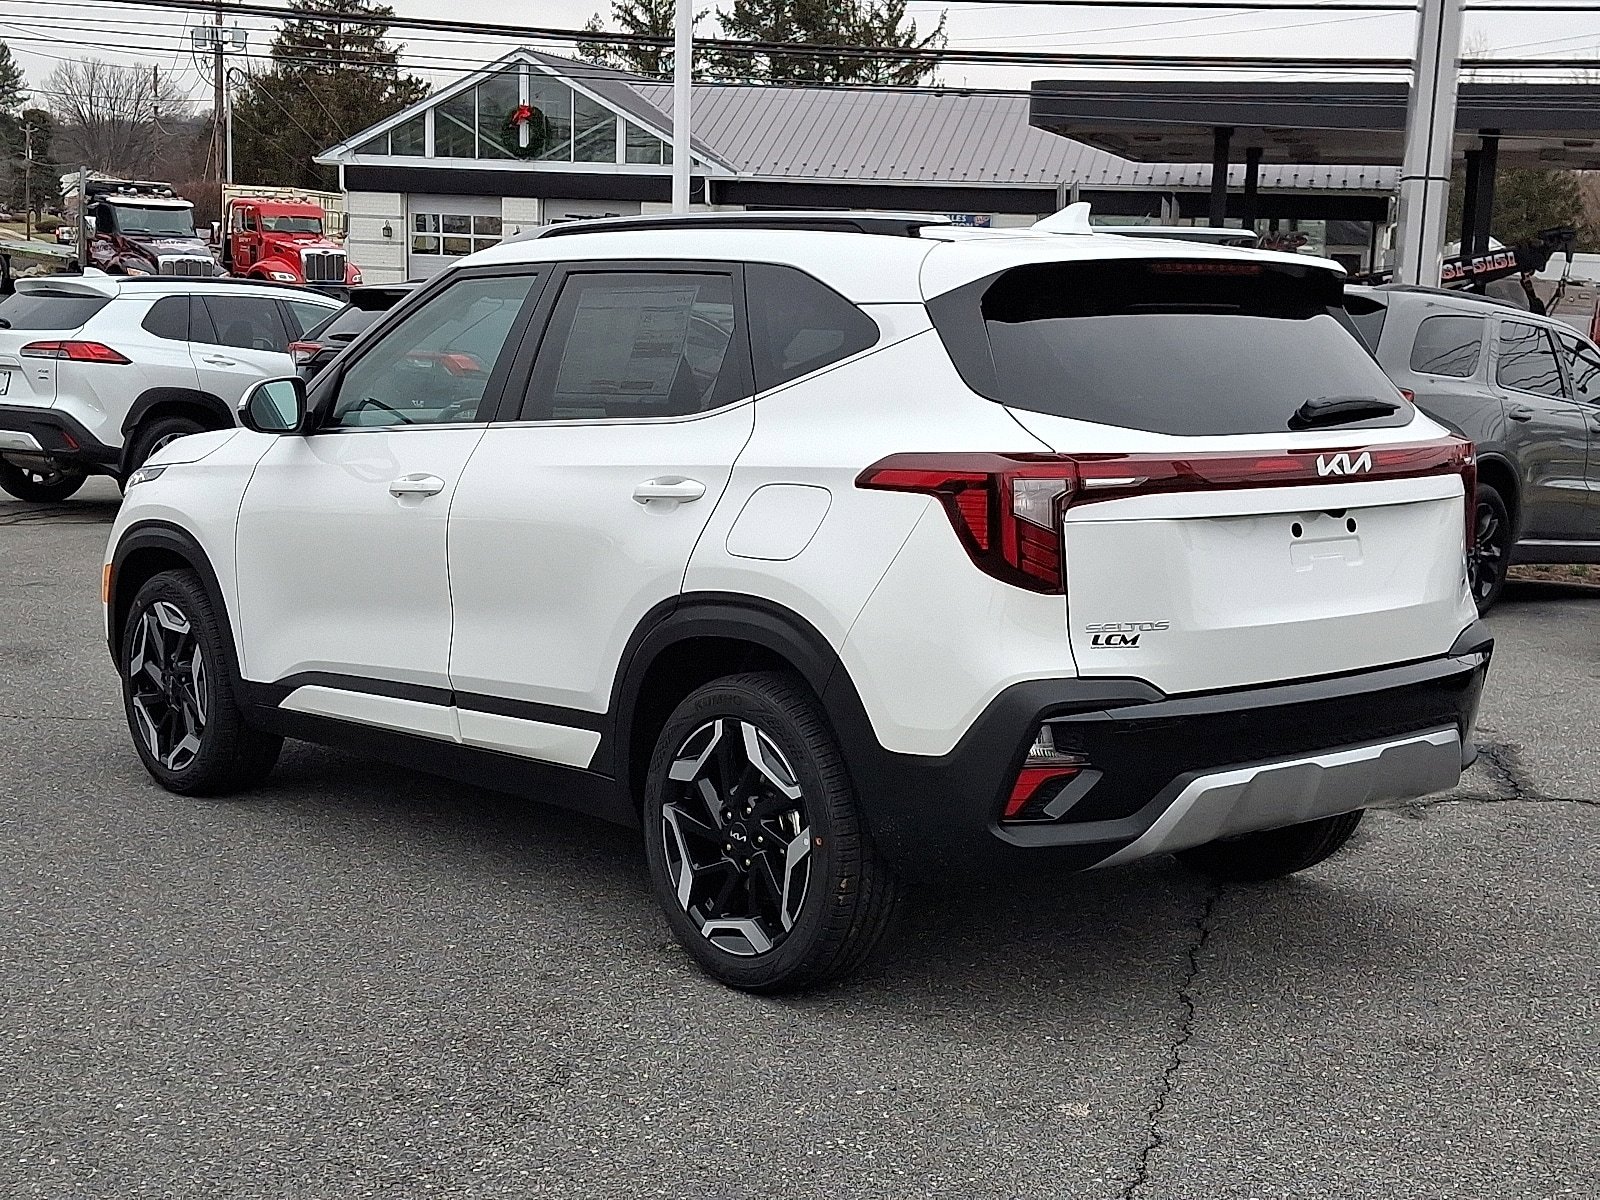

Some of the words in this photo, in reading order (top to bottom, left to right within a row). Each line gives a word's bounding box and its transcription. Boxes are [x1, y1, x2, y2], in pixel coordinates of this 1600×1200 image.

[1316, 451, 1372, 477] KIA
[1085, 620, 1170, 634] SELTOS
[1091, 633, 1141, 647] LCM
